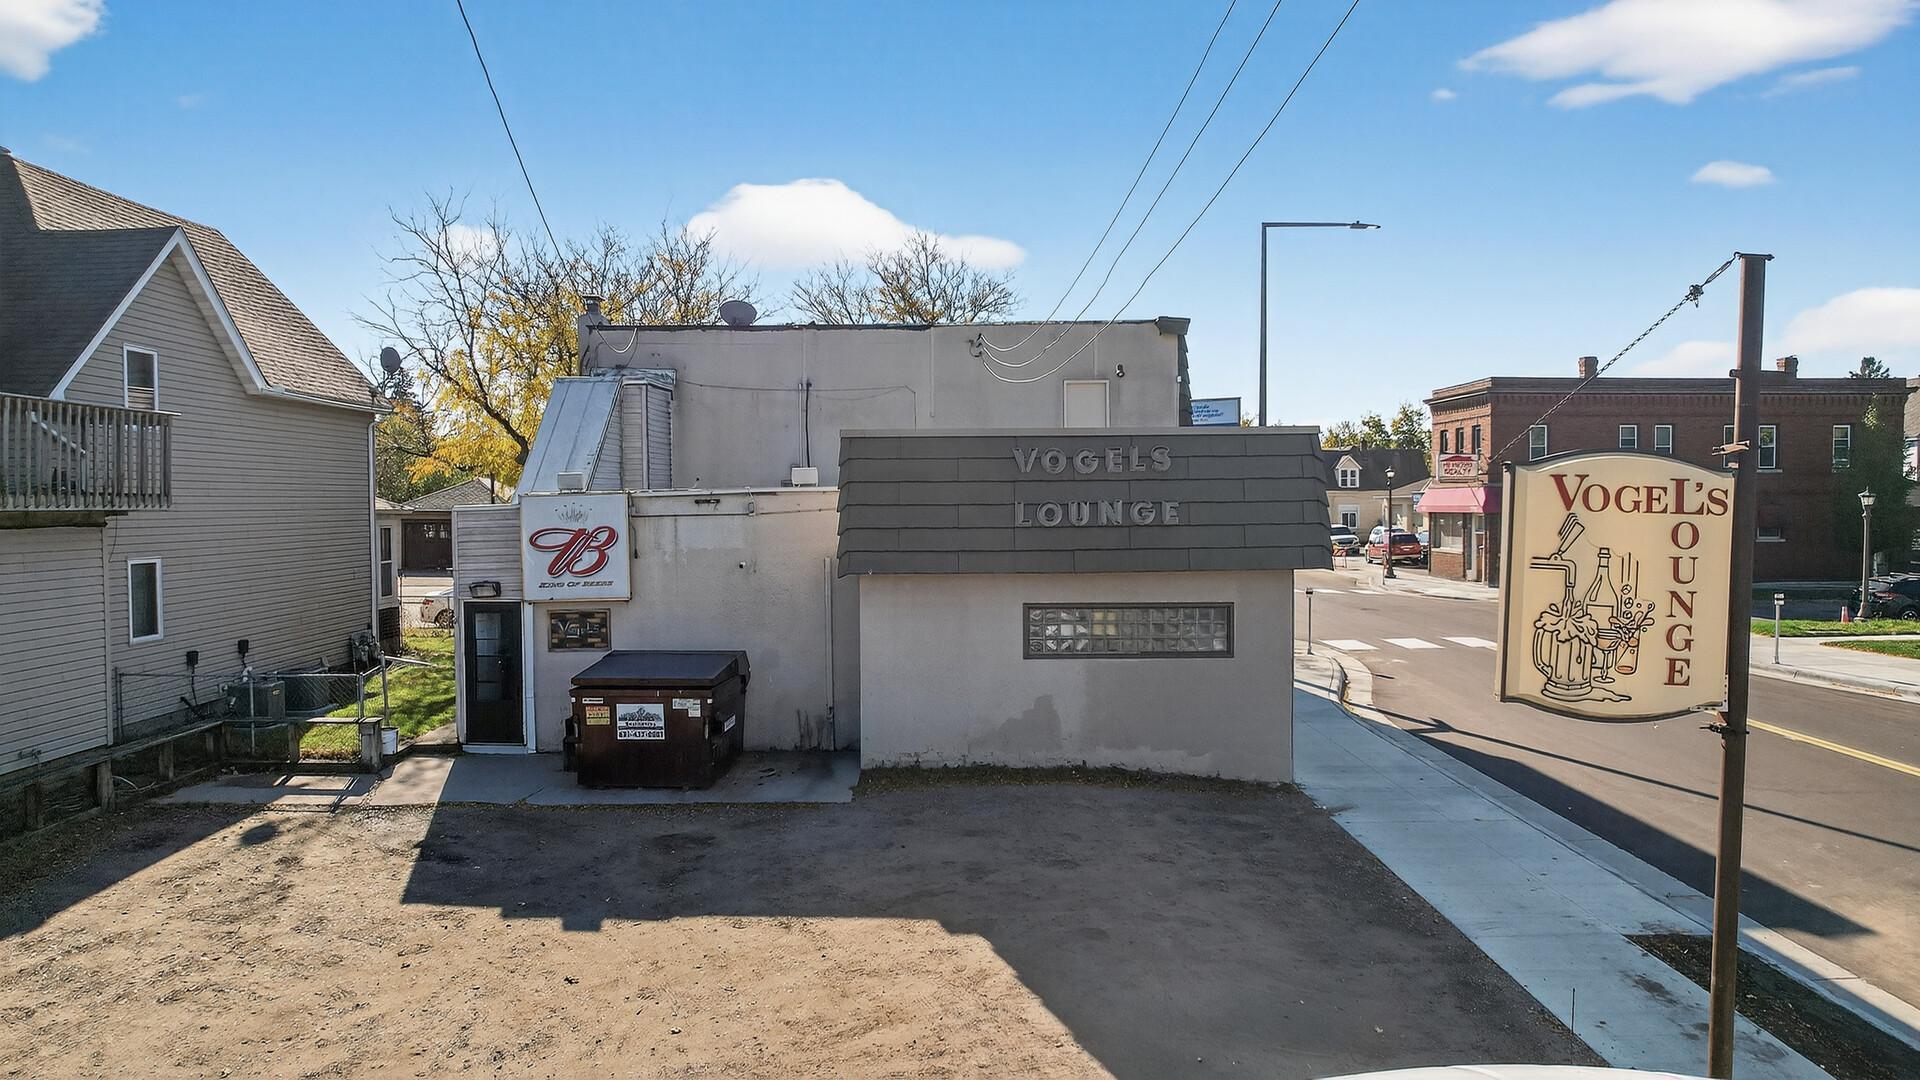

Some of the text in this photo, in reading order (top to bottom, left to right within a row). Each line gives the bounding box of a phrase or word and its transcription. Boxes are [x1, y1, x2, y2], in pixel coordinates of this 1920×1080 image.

[1012, 444, 1172, 475] VOGELS
[1549, 473, 1729, 516] VOGEL'S
[1014, 498, 1180, 528] LOUNGE
